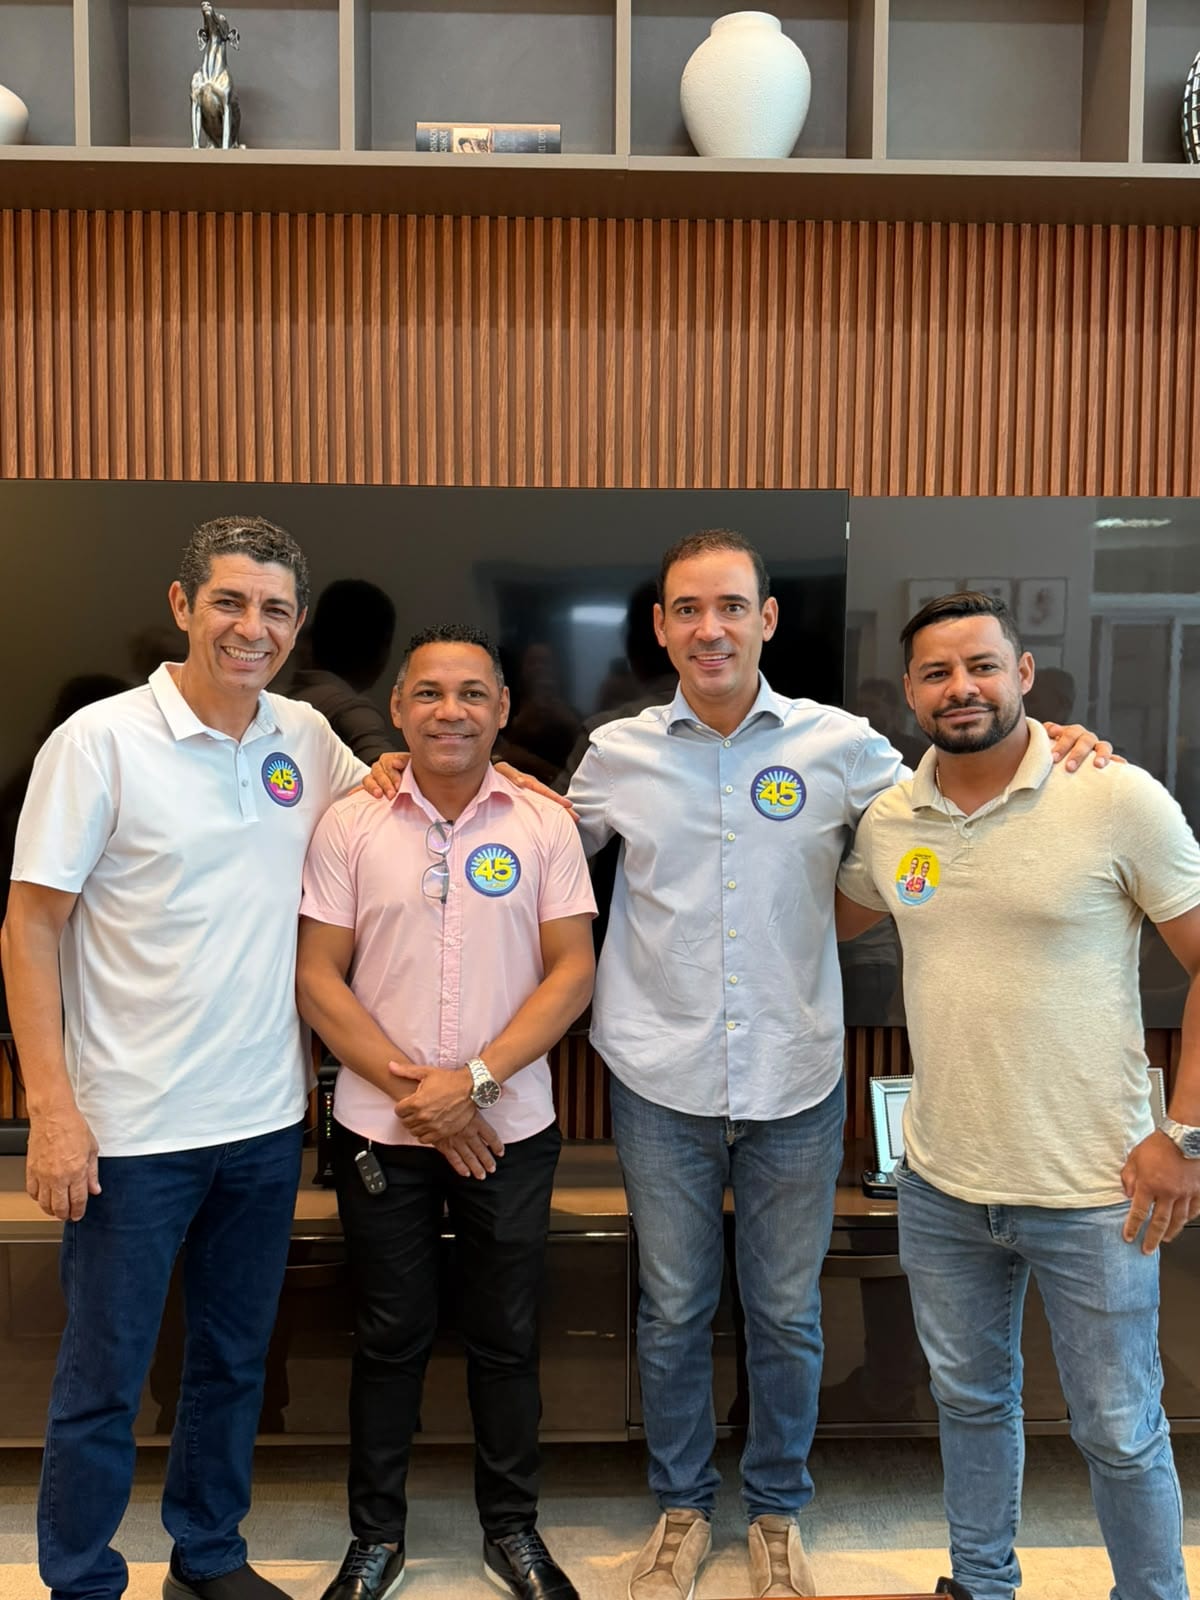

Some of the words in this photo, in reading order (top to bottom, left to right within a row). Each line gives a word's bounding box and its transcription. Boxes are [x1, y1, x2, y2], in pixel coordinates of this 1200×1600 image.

[270, 768, 296, 791] 45
[759, 781, 798, 806] 45
[474, 857, 513, 881] 45
[905, 876, 924, 892] 45
